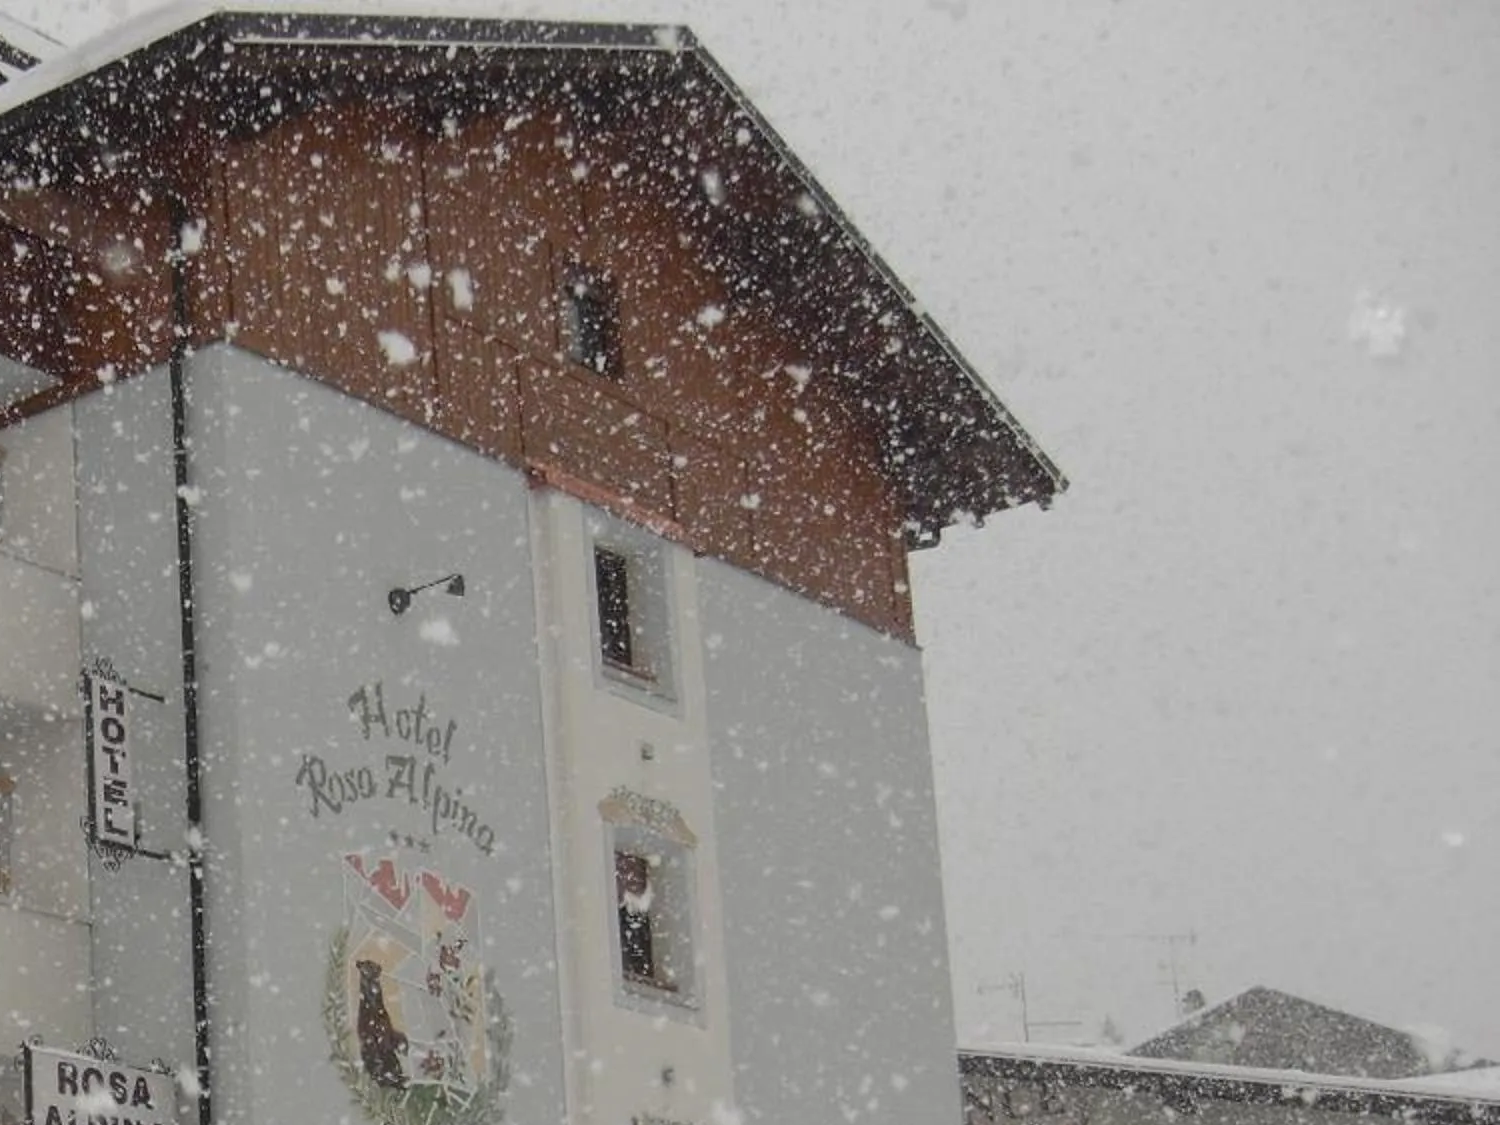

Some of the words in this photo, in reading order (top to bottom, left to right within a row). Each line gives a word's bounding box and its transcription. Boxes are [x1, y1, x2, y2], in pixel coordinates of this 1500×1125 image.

[99, 684, 129, 837] HOTEL
[348, 681, 458, 766] Hotel
[296, 754, 378, 818] Rosa
[386, 755, 495, 856] Alpina
[57, 1061, 154, 1110] ROSA
